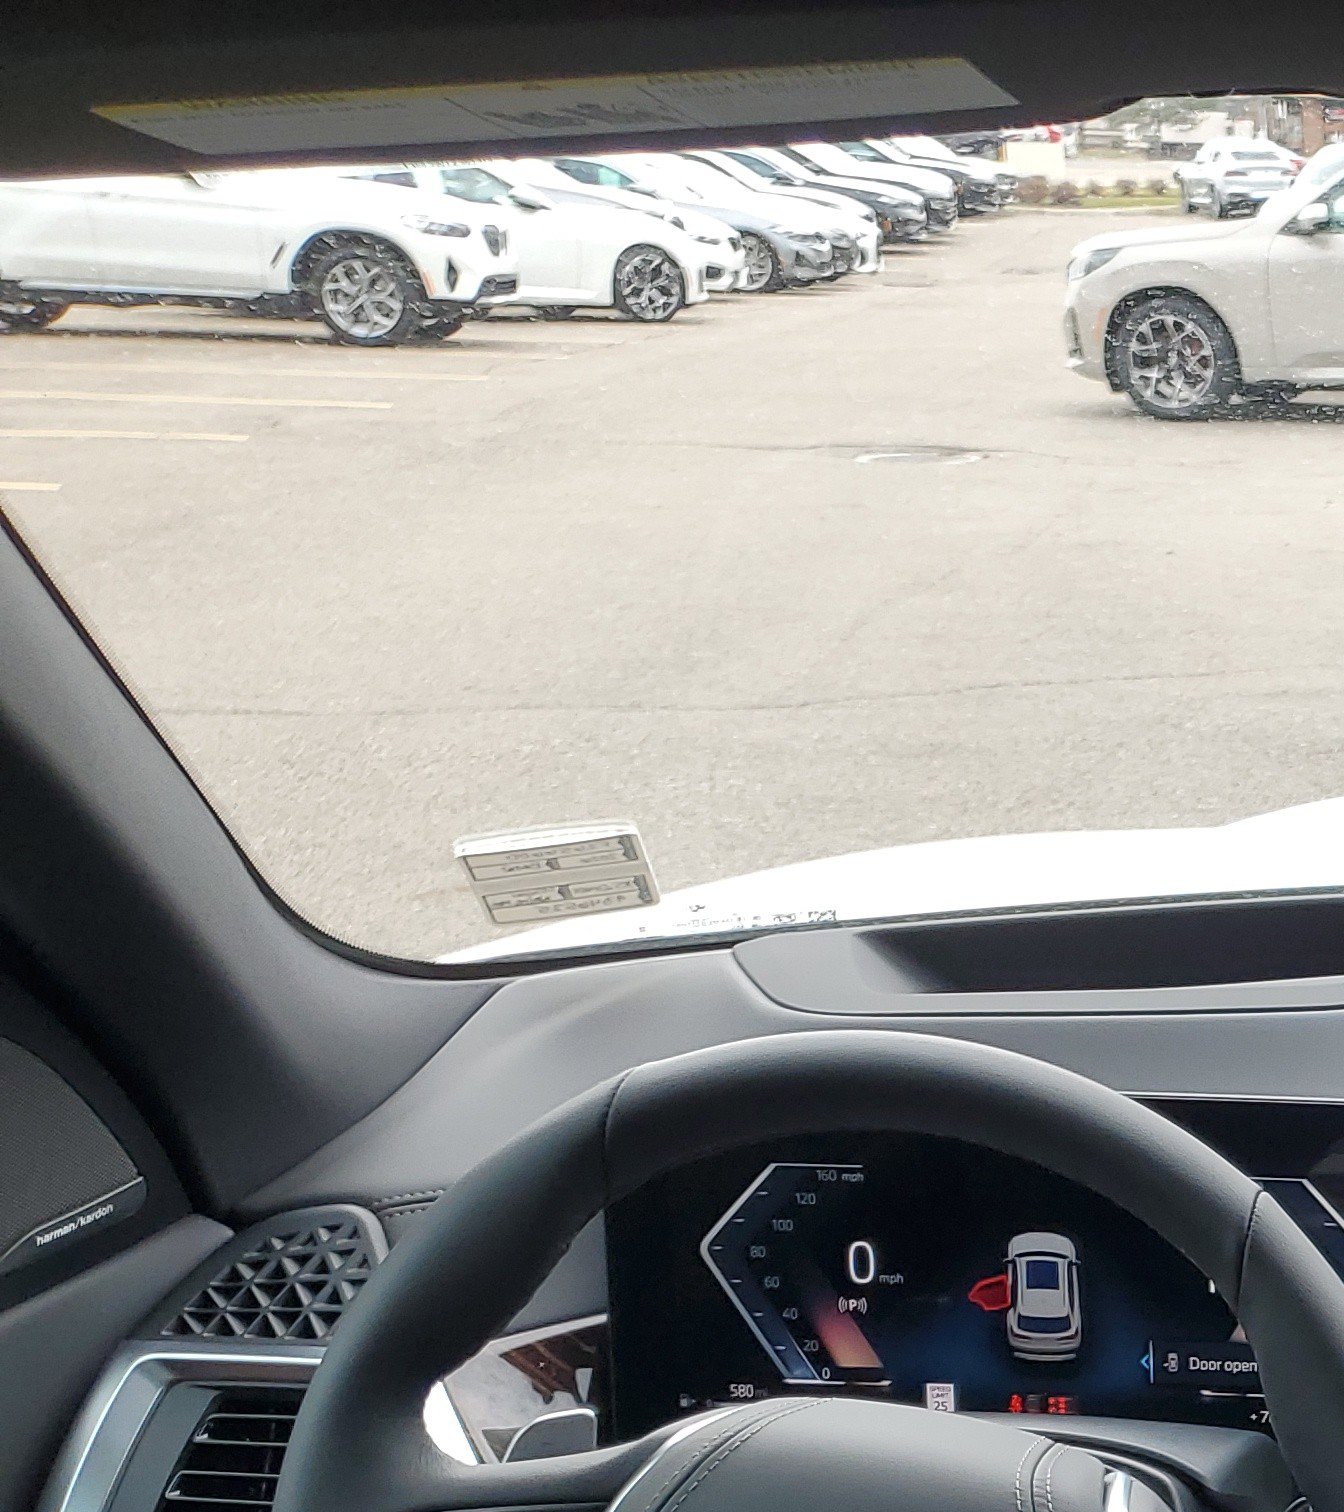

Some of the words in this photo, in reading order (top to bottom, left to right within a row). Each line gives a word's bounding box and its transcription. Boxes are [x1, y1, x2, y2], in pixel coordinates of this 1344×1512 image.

[816, 1169, 837, 1182] 160
[842, 1172, 864, 1184] mph
[795, 1192, 816, 1205] 120
[36, 1203, 114, 1247] harman/kardon
[772, 1219, 794, 1232] 100
[750, 1245, 766, 1258] 80
[849, 1240, 875, 1284] 0
[879, 1273, 904, 1287] mph
[764, 1276, 780, 1288] 60
[782, 1307, 798, 1320] 40
[804, 1340, 819, 1352] 20
[1188, 1357, 1222, 1371] Door
[1224, 1360, 1258, 1374] open
[822, 1367, 830, 1380] 0
[729, 1383, 754, 1398] 580
[934, 1400, 949, 1412] 25
